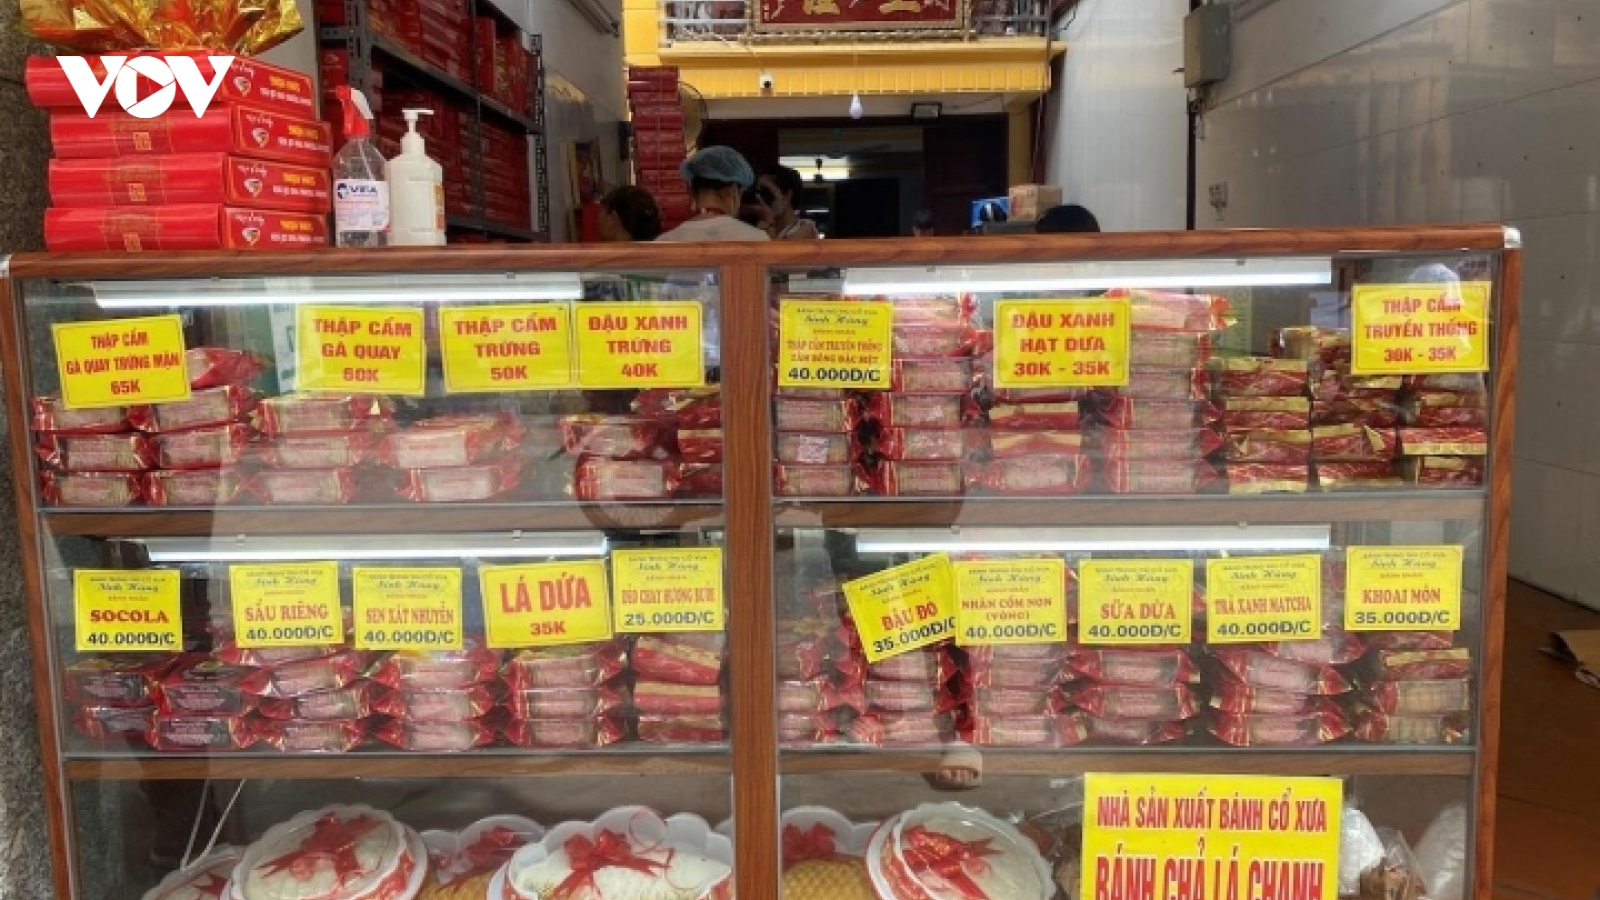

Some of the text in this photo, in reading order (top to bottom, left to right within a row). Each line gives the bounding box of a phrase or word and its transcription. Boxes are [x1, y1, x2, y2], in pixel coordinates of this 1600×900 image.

[1382, 296, 1422, 316] THẬP
[313, 315, 412, 339] THẬP CẨM
[454, 312, 556, 337] THẬP CẨM
[635, 315, 688, 331] XANH
[1060, 312, 1115, 328] XANH
[1364, 316, 1478, 340] TRUYỀN THỐNG
[91, 333, 121, 350] THẬP
[322, 339, 401, 360] GÀ QUAY
[475, 340, 541, 358] TRỨNG
[606, 336, 671, 353] TRỨNG
[1020, 338, 1058, 354] HẠT
[1384, 348, 1413, 363] 30K
[1428, 346, 1456, 362] 35K
[66, 359, 82, 375] GÀ
[84, 357, 110, 374] QUAY
[343, 367, 379, 382] 60K
[490, 365, 528, 380] 50K
[621, 363, 658, 378] 40K
[1014, 362, 1052, 376] 30K
[1072, 361, 1110, 376] 35K
[111, 379, 141, 395] 65K
[500, 571, 592, 613] LÁ DỨA
[1362, 589, 1408, 604] KHOAI
[90, 609, 170, 624] SOCOLA
[280, 600, 329, 620] RIÊNG
[1100, 598, 1136, 620] SỮA
[530, 620, 567, 636] 35K
[1097, 786, 1328, 832] NHÀ SẢN XUẤT BÁNH CỔ XƯA
[1096, 836, 1324, 900] BÁNH CHẢ LÁ CHANH
